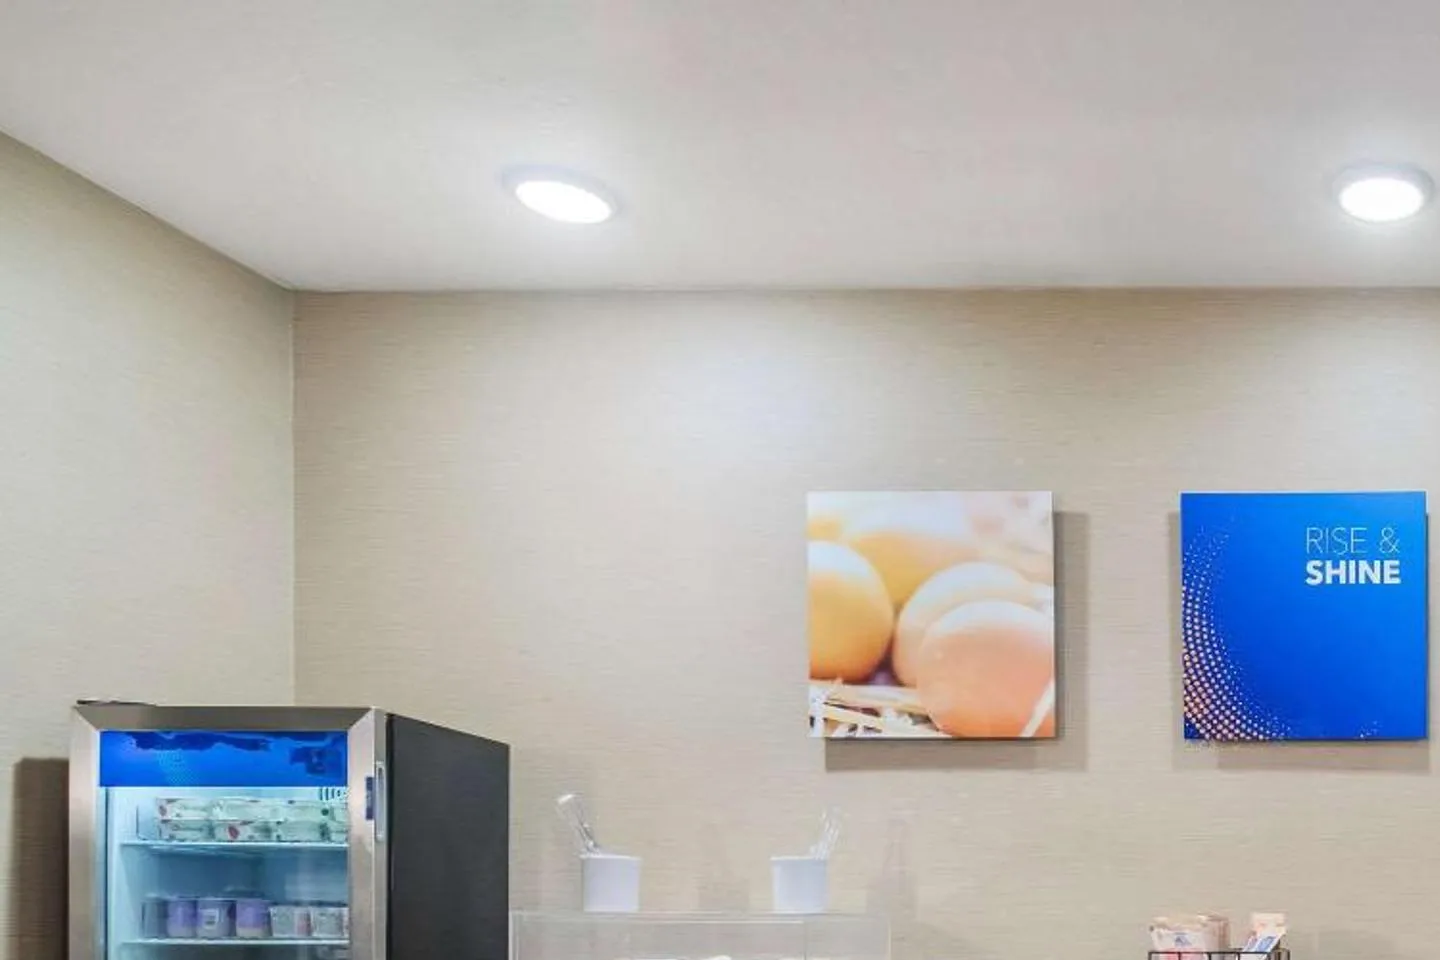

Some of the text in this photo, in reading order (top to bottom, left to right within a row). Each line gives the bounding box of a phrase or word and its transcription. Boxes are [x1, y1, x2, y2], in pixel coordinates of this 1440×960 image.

[1305, 527, 1401, 555] RISE &
[1305, 559, 1401, 585] SHINE
